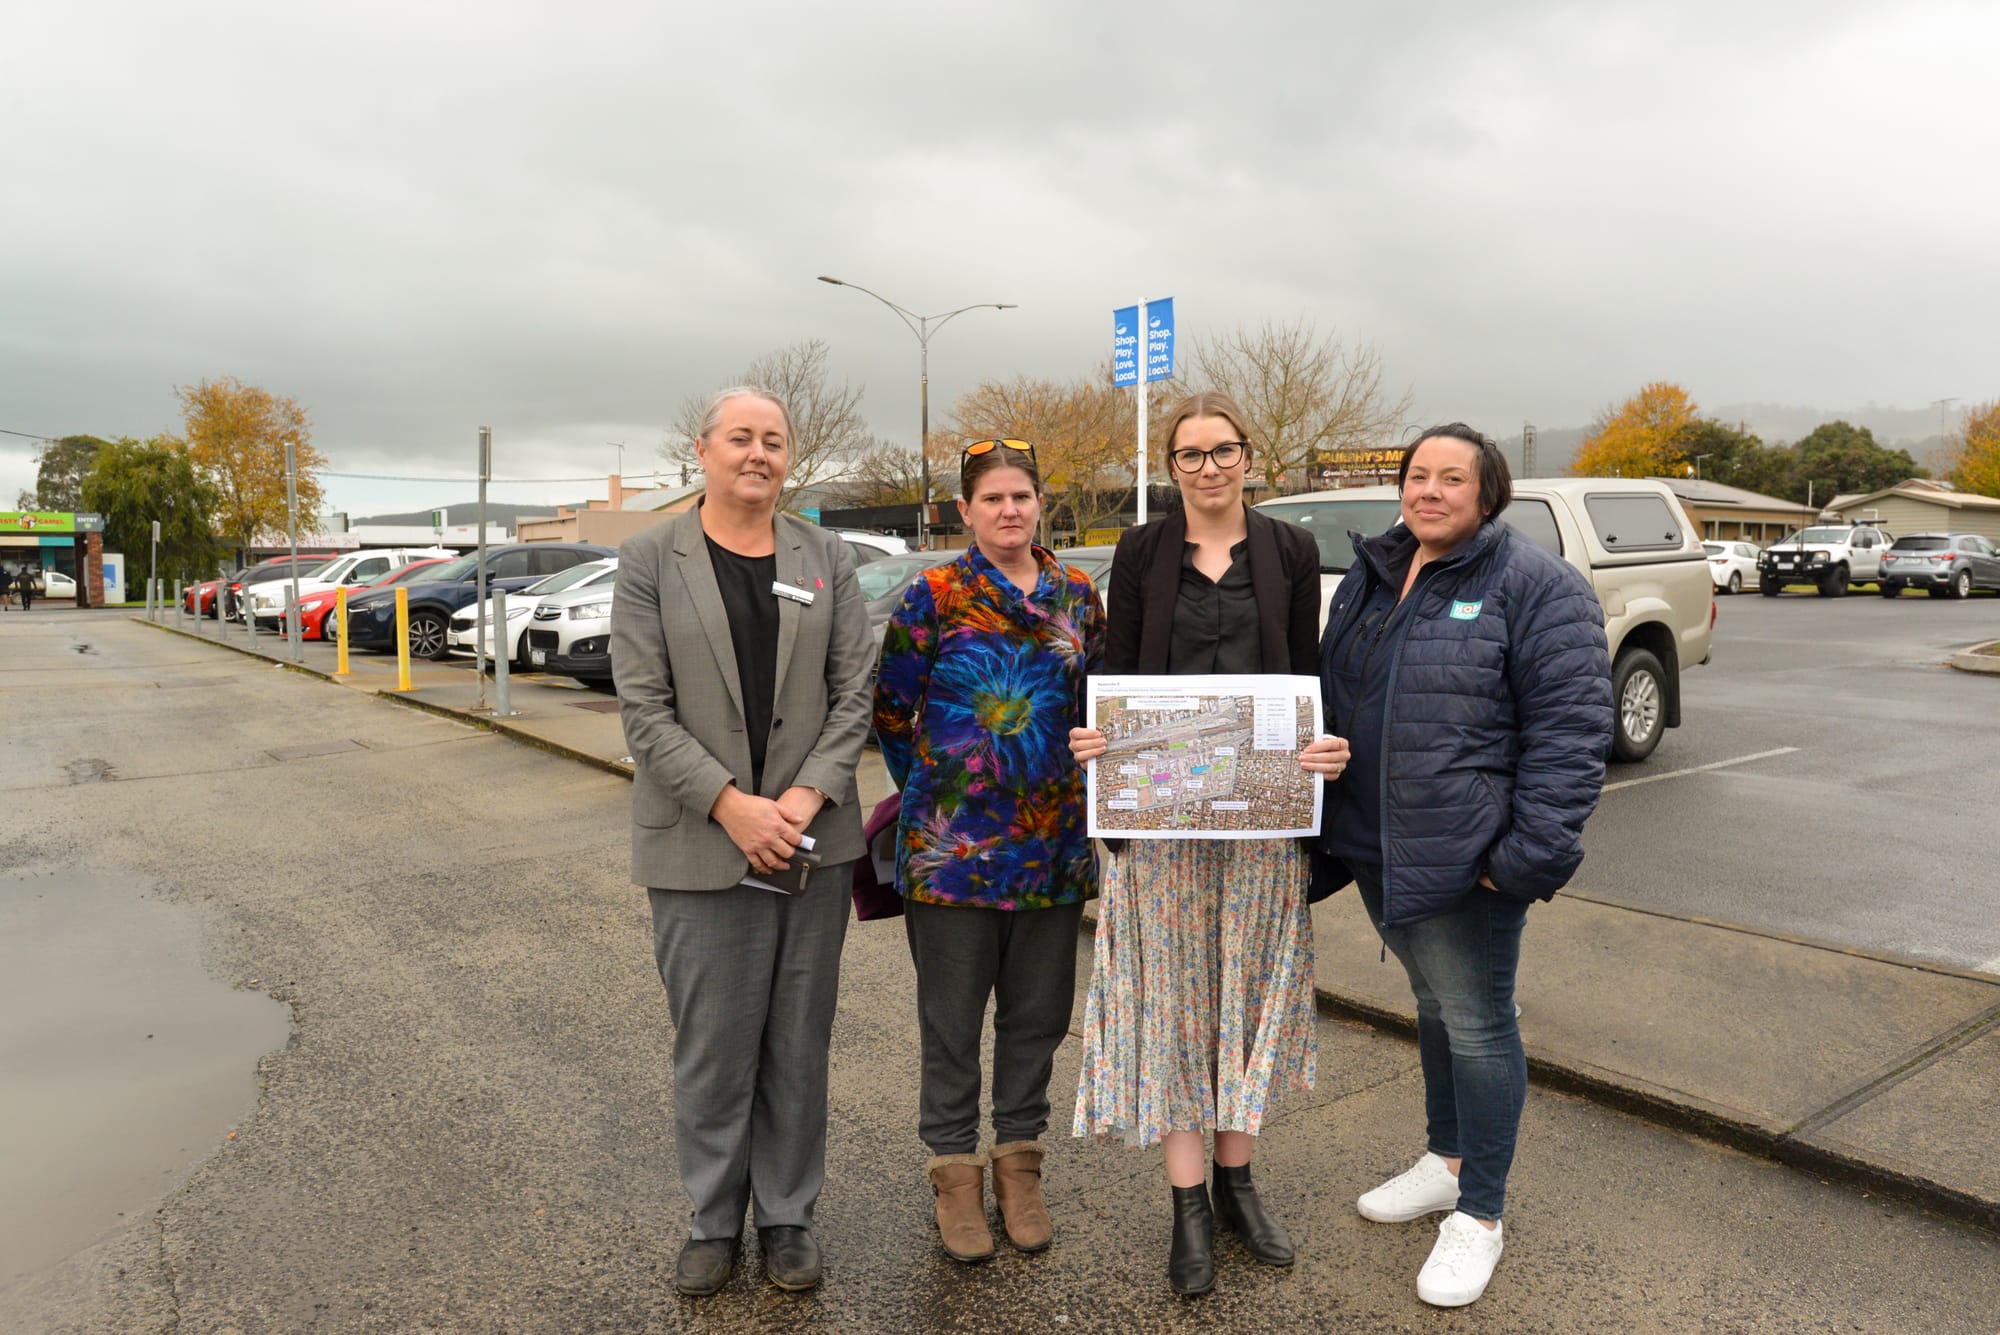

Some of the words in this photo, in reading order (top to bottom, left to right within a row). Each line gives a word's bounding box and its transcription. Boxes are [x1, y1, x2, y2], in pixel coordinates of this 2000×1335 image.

[1149, 329, 1172, 340] Shop.
[1115, 336, 1137, 346] Shop.
[1149, 341, 1168, 352] Play.
[1115, 348, 1134, 359] Play.
[1149, 354, 1168, 364] Love.
[1115, 360, 1135, 370] Love.
[1148, 364, 1170, 376] Local.
[1115, 370, 1137, 382] Local.
[1318, 450, 1384, 463] MURPHY'S
